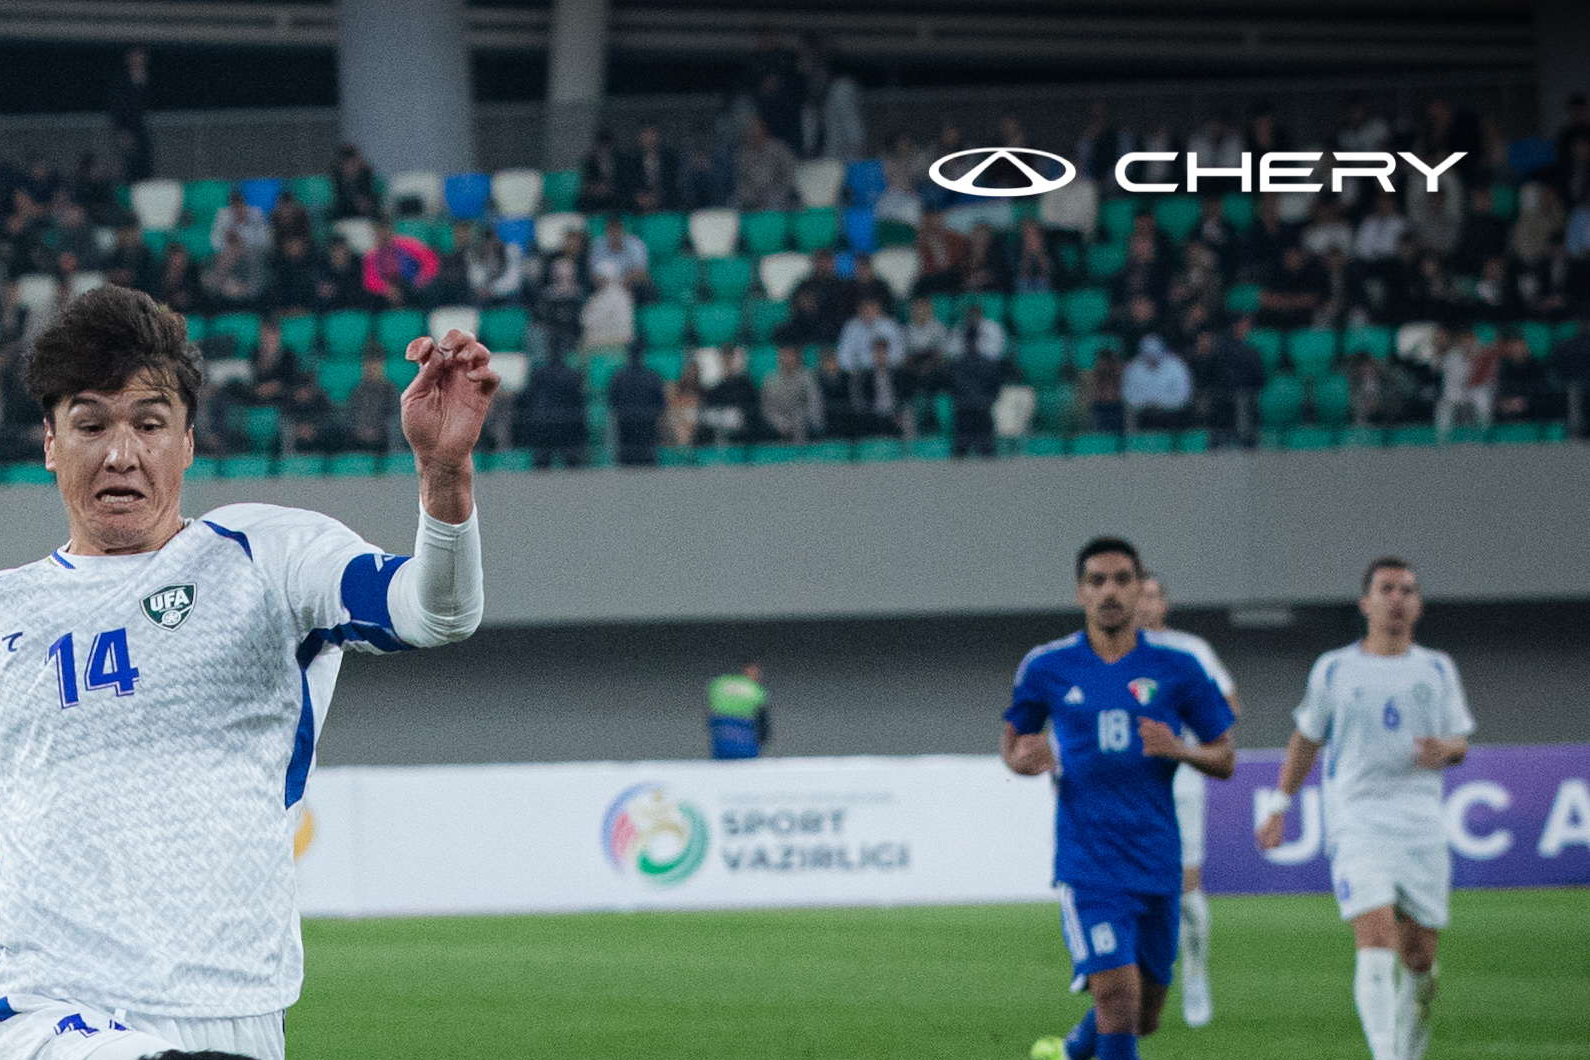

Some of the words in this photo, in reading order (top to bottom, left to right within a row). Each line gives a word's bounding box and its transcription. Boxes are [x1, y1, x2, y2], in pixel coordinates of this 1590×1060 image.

[150, 588, 190, 613] UFA
[45, 627, 140, 710] 14
[1097, 709, 1131, 753] 18
[1382, 698, 1401, 732] 6
[721, 808, 846, 838] SPORT
